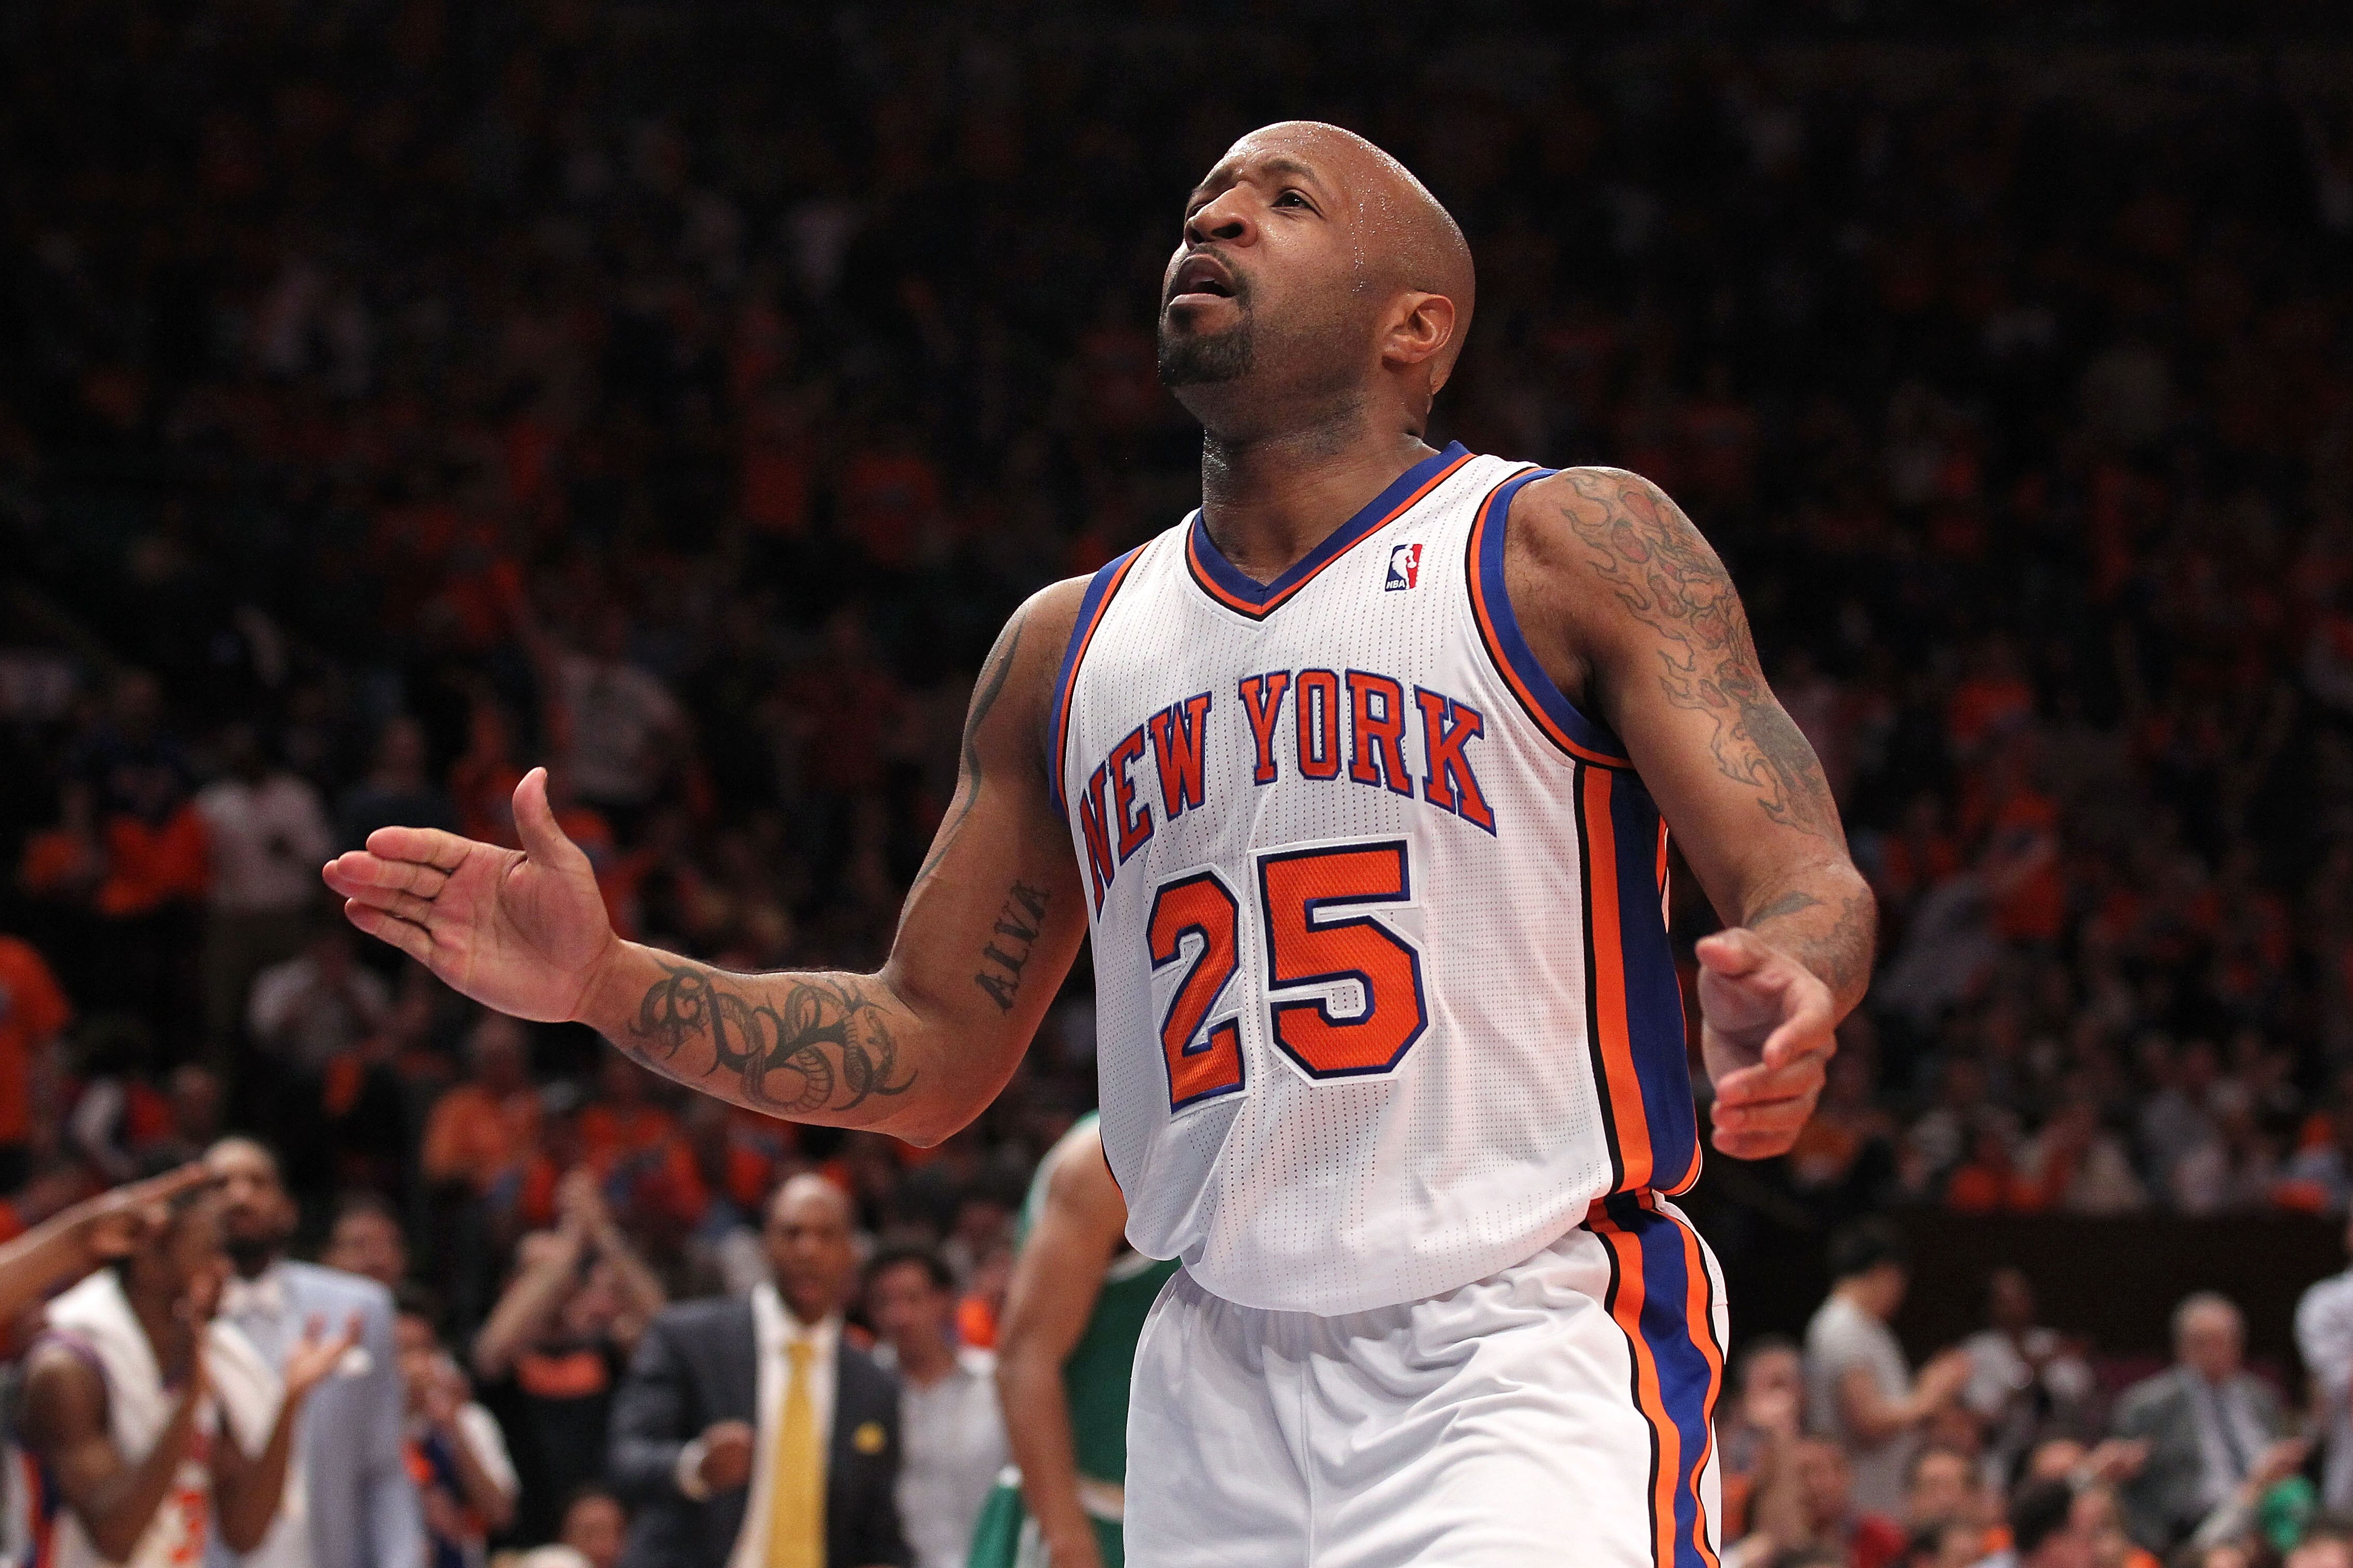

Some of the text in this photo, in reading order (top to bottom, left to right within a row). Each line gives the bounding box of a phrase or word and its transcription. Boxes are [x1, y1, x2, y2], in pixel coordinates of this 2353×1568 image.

[1385, 579, 1406, 589] NBA
[1080, 668, 1497, 924] NEW YORK
[974, 879, 1051, 1017] ALVA
[1145, 839, 1429, 1114] 25
